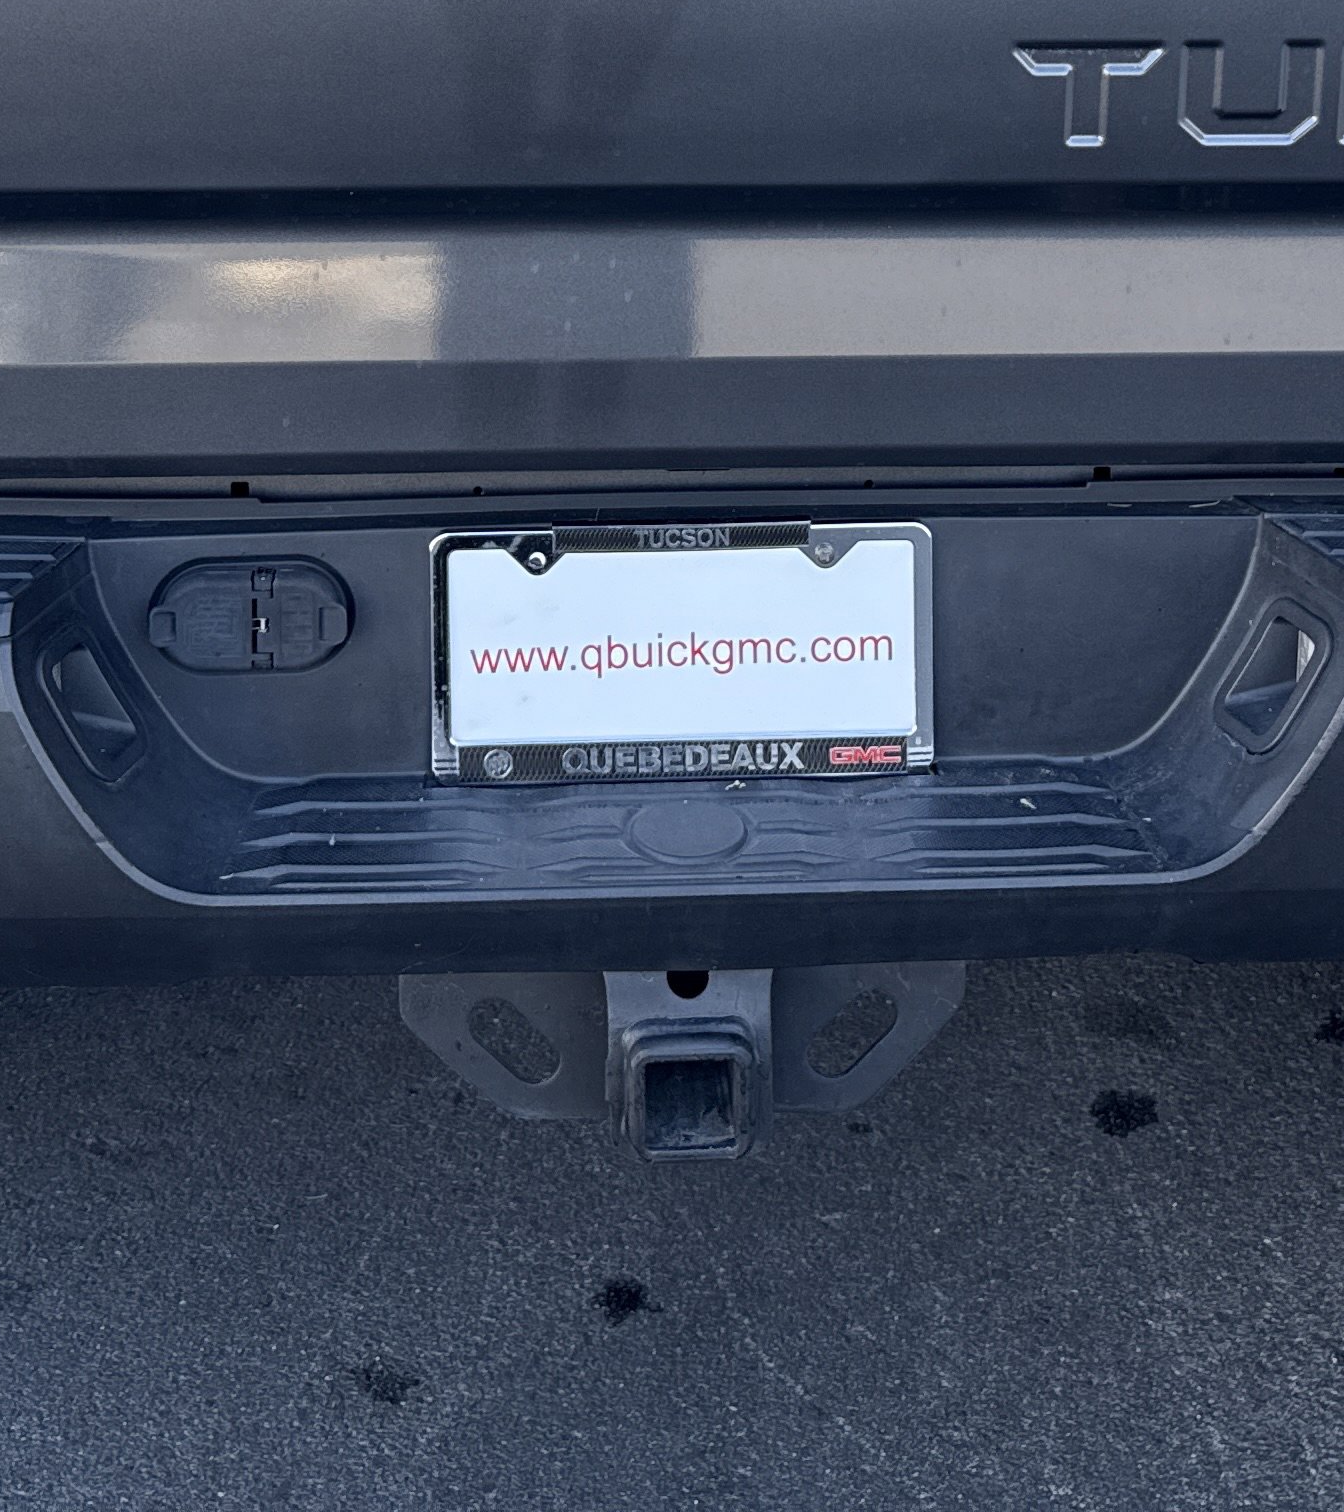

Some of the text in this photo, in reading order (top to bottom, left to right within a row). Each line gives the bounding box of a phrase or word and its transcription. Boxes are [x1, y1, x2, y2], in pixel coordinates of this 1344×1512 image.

[635, 527, 731, 548] TUCSON
[470, 631, 894, 678] www.qbuickgmc.com
[561, 741, 903, 775] QUEBEDEAUX GMC
